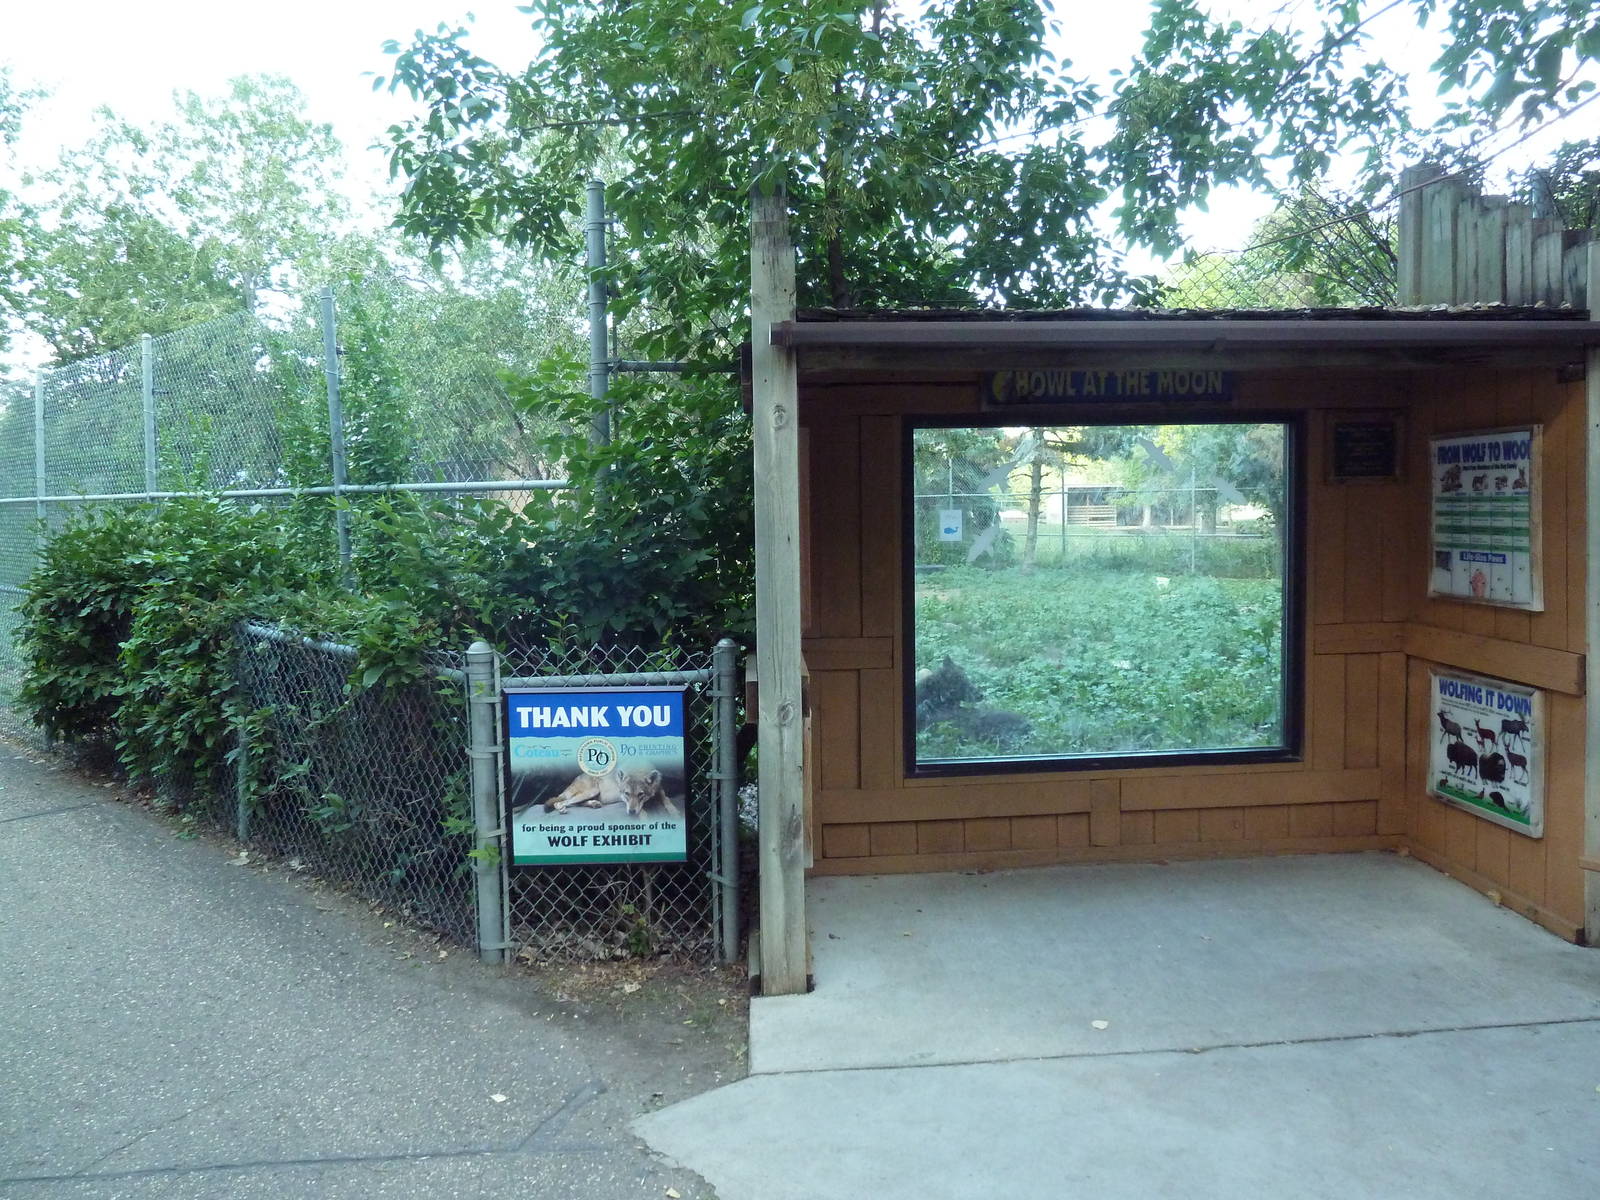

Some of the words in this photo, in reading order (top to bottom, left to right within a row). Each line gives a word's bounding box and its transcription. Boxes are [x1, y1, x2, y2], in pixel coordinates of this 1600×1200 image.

[1015, 372, 1076, 396] HOWL
[1083, 371, 1107, 396] AT
[1114, 371, 1151, 395] THE
[1158, 370, 1223, 394] MOON
[1438, 445, 1460, 464] FROM
[1462, 443, 1486, 462] WOLF
[1488, 441, 1500, 461] TO
[1439, 679, 1482, 705] WOLFING
[1485, 689, 1495, 707] IT
[1497, 692, 1532, 717] DOWN
[516, 706, 609, 728] THANK
[616, 705, 670, 727] YOU
[522, 823, 536, 832] for
[539, 823, 566, 834] being
[576, 823, 604, 834] proud
[608, 823, 646, 833] sponsor
[650, 822, 658, 830] of
[661, 822, 676, 830] the
[548, 835, 588, 847] WOLF
[593, 834, 652, 846] EXHIBIT
